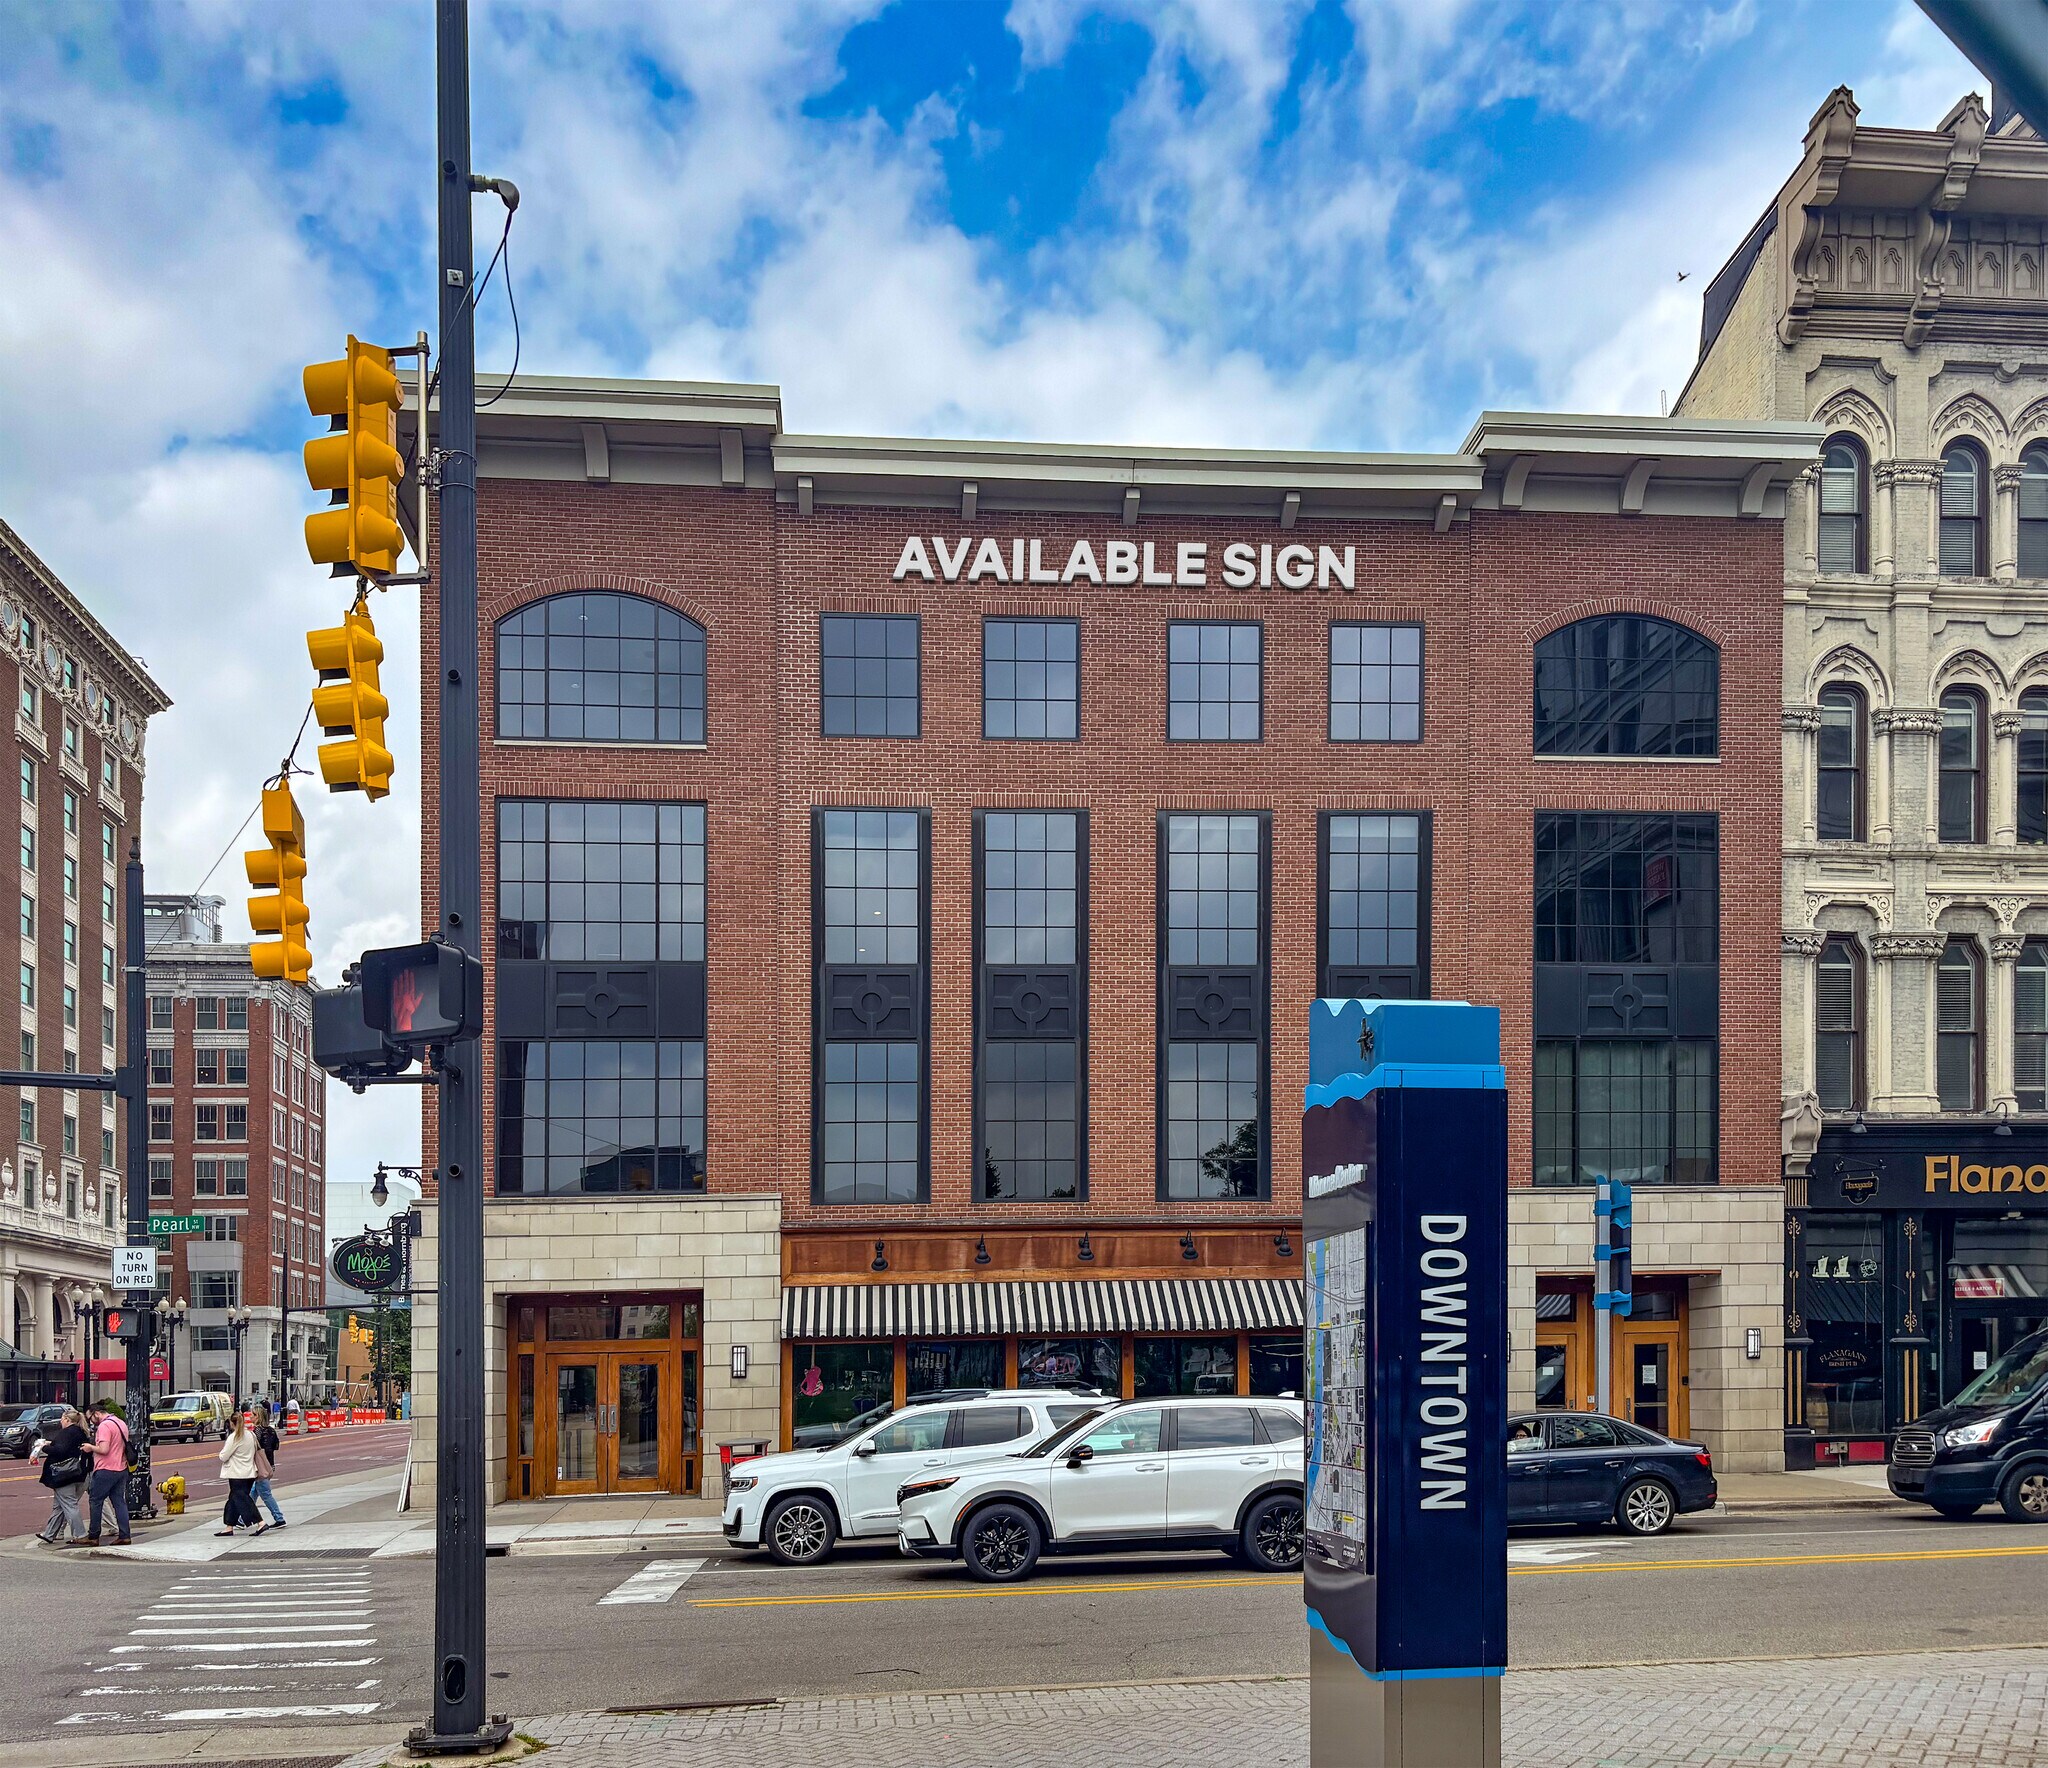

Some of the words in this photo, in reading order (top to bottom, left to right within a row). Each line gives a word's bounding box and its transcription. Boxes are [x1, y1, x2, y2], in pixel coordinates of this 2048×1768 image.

[893, 536, 1207, 586] AVAILABLE
[1222, 543, 1356, 590] SIGN
[1924, 1155, 2048, 1194] Flana
[153, 1217, 189, 1231] Pearl
[127, 1252, 143, 1260] NO
[121, 1264, 147, 1272] TURN
[116, 1276, 129, 1284] ON
[134, 1276, 153, 1284] RED
[1420, 1215, 1468, 1510] DOWNTOWN
